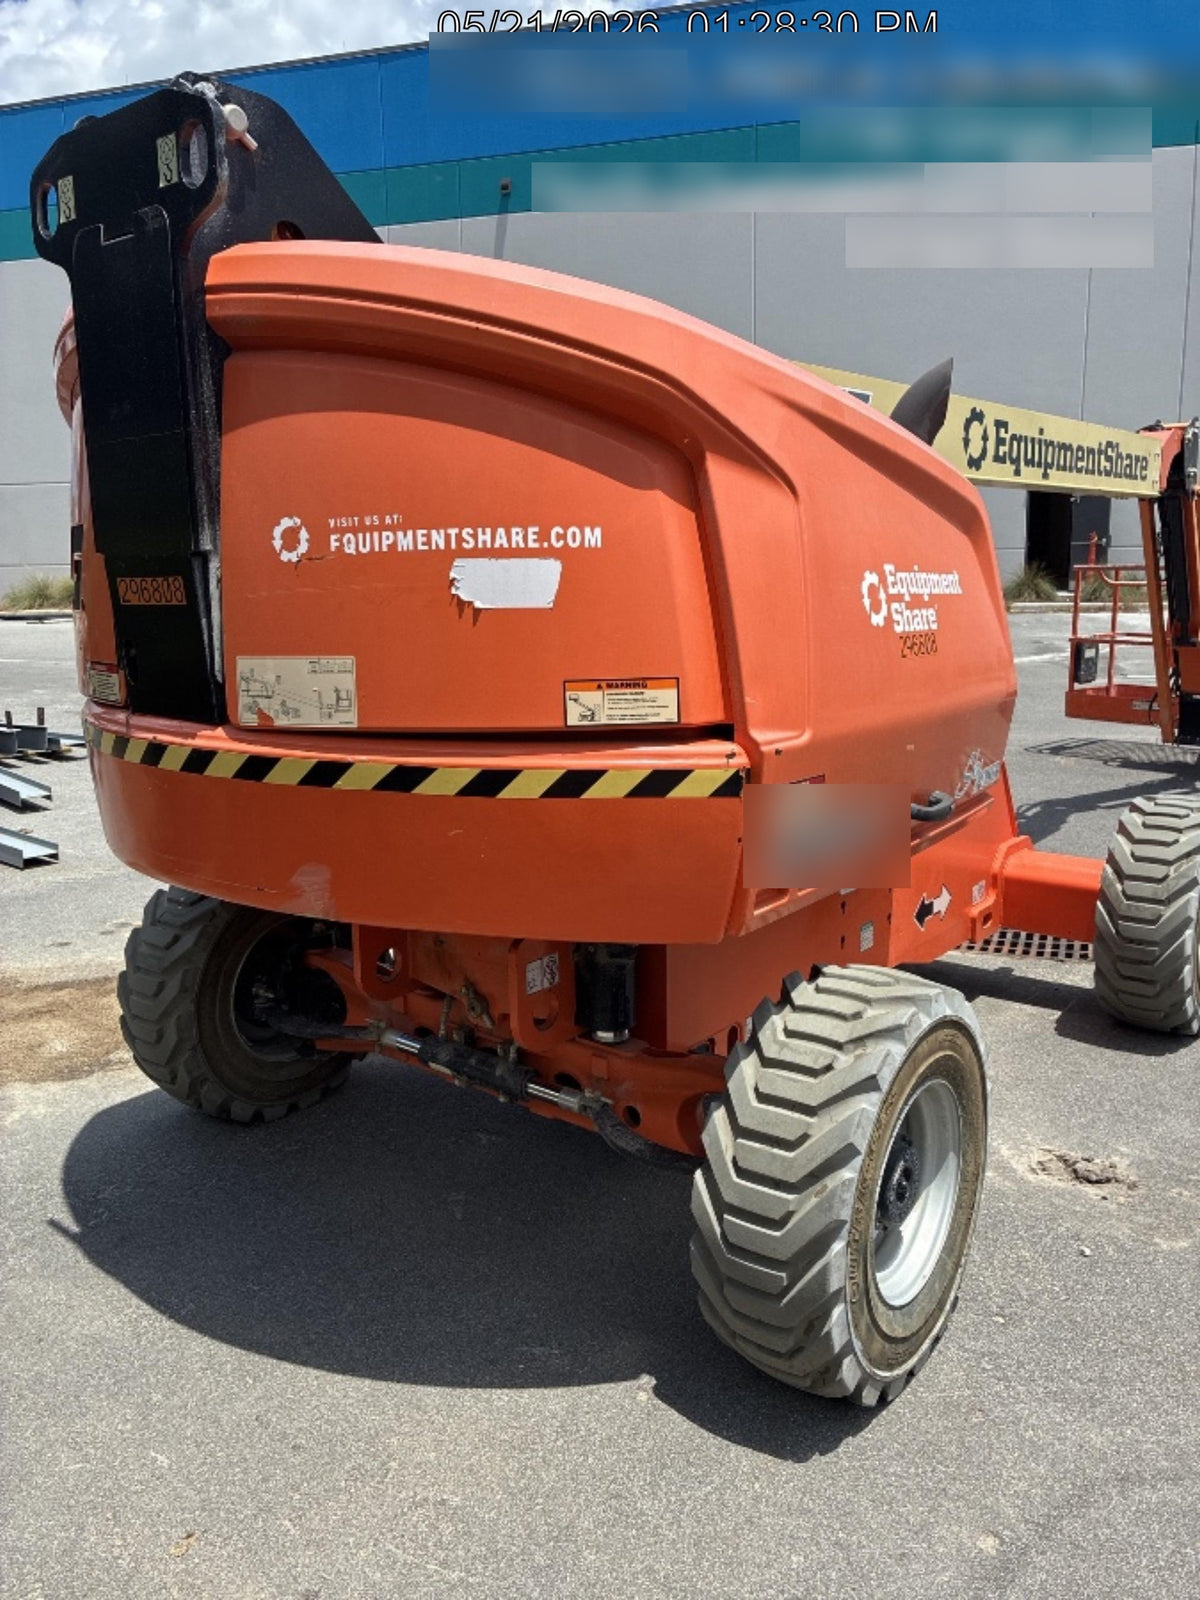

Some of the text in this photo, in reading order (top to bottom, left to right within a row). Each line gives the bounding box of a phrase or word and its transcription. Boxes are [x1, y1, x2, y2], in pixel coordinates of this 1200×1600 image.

[993, 420, 1149, 481] EquipmentShare
[328, 517, 359, 528] VISIT
[364, 515, 380, 525] US
[119, 578, 184, 603] 296808
[883, 563, 963, 601] Equipment
[891, 602, 938, 633] Share
